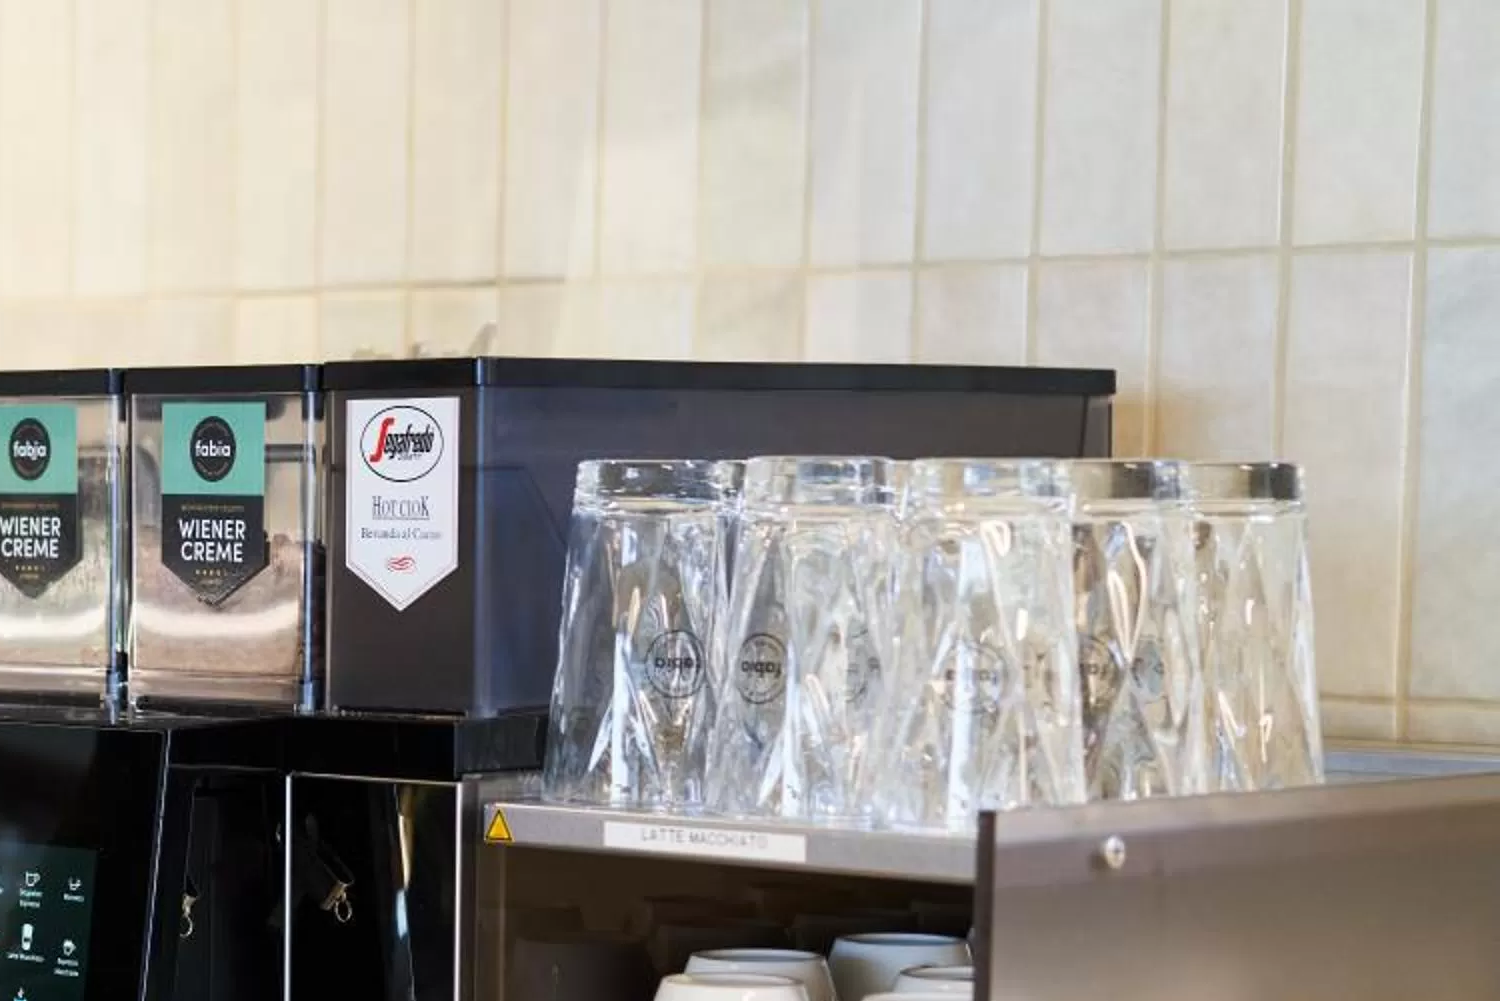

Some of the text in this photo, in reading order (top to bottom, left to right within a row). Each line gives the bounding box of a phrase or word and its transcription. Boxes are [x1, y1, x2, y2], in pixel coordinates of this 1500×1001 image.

[195, 440, 231, 457] fabia
[0, 516, 61, 537] WIENER
[179, 518, 246, 540] WIENER
[1, 538, 59, 558] CREME
[181, 541, 243, 563] CREME
[641, 827, 685, 844] LATTE
